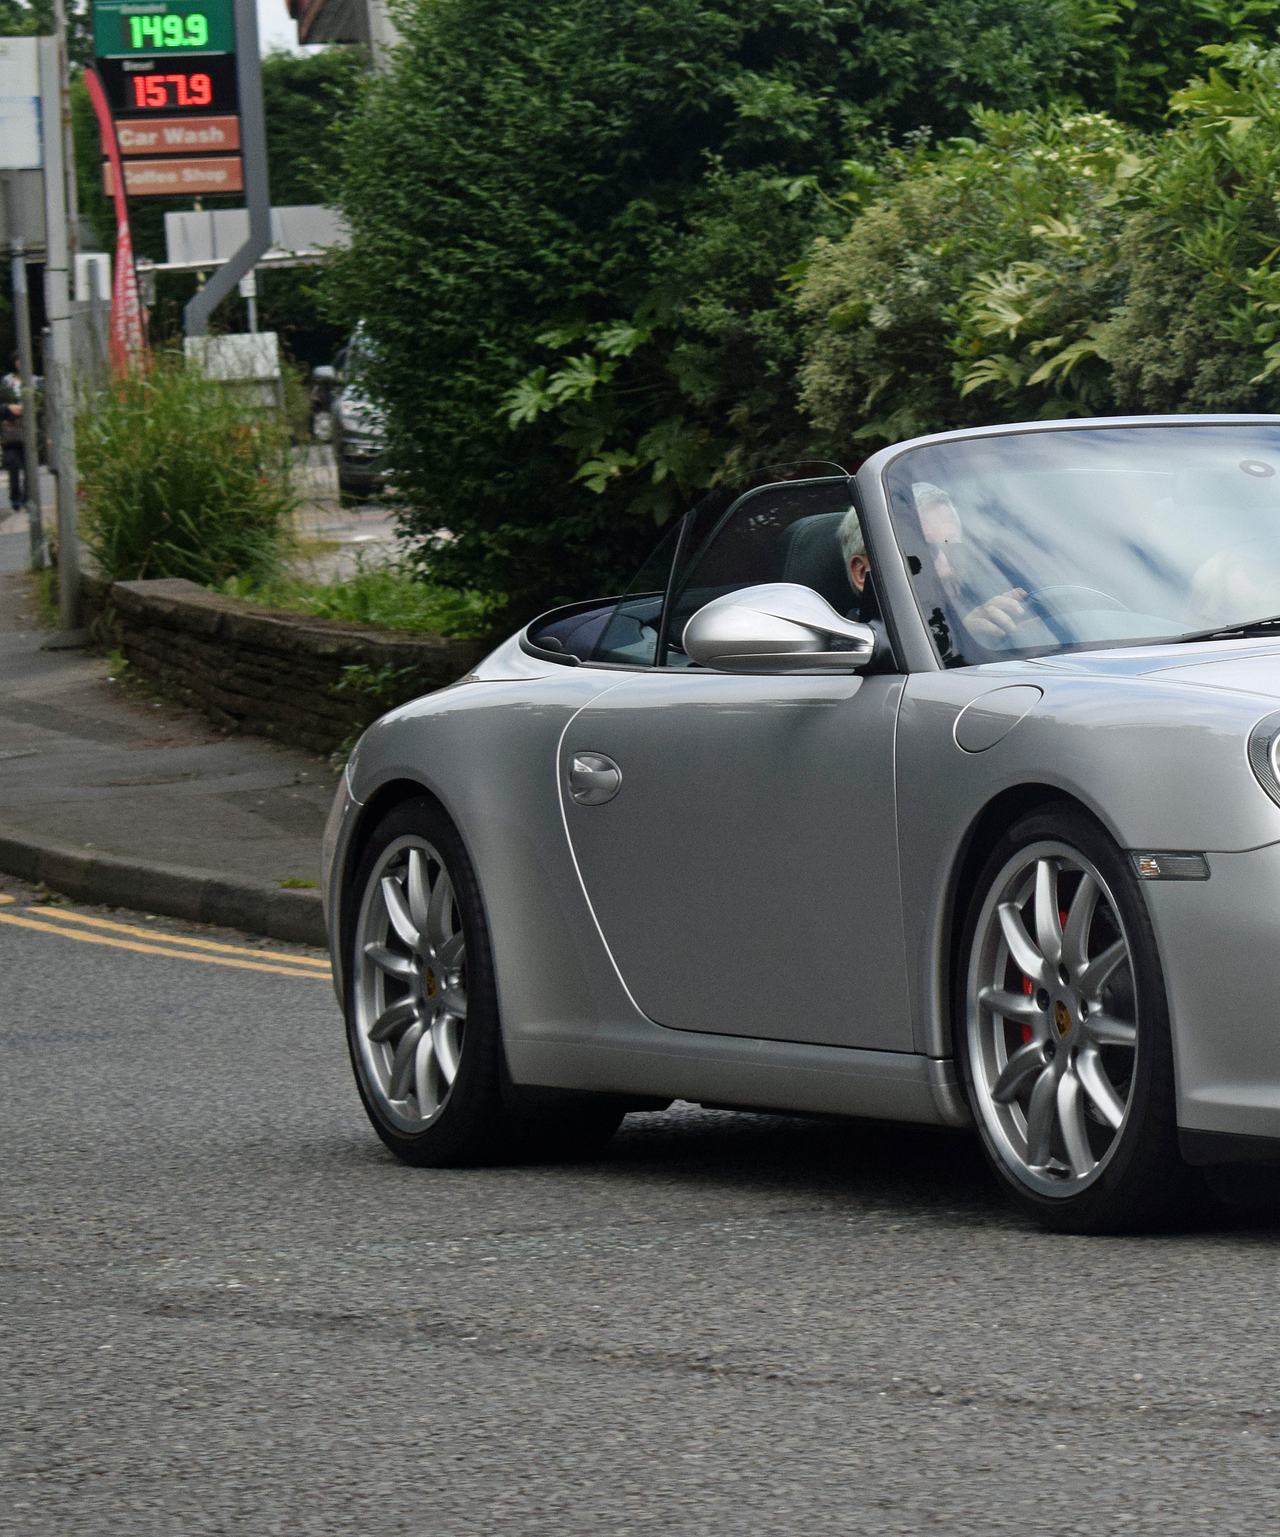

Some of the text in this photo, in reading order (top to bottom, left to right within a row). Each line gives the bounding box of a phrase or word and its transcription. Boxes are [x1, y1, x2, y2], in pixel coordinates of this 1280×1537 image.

[129, 13, 209, 48] 149.9
[133, 73, 212, 107] 157.9
[118, 126, 224, 147] Car Wash
[181, 168, 227, 183] Shop
